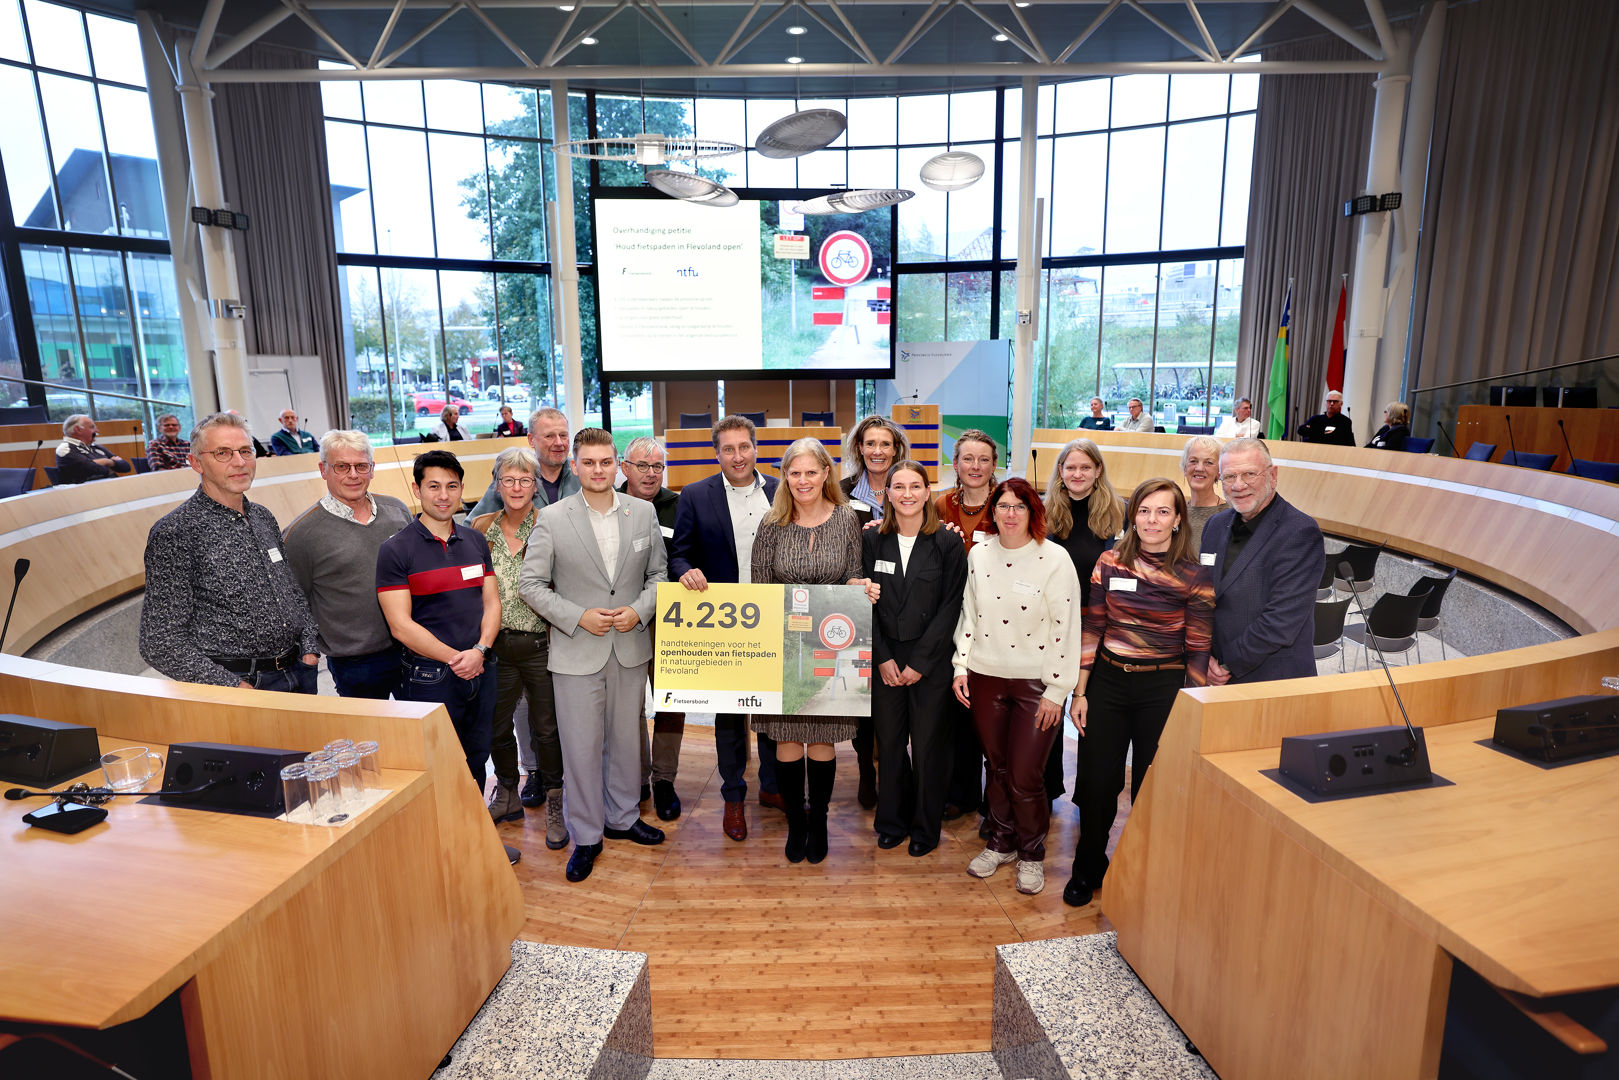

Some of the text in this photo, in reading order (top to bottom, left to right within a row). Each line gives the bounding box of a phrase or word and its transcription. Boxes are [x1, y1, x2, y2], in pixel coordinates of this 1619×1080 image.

[613, 227, 666, 235] Overhandiging
[662, 601, 761, 629] 4.239
[660, 640, 725, 649] handtekeningen
[660, 649, 713, 657] openhouden
[731, 650, 777, 659] fietspaden
[669, 658, 733, 667] natuurgebieden
[660, 666, 699, 675] Flevoland
